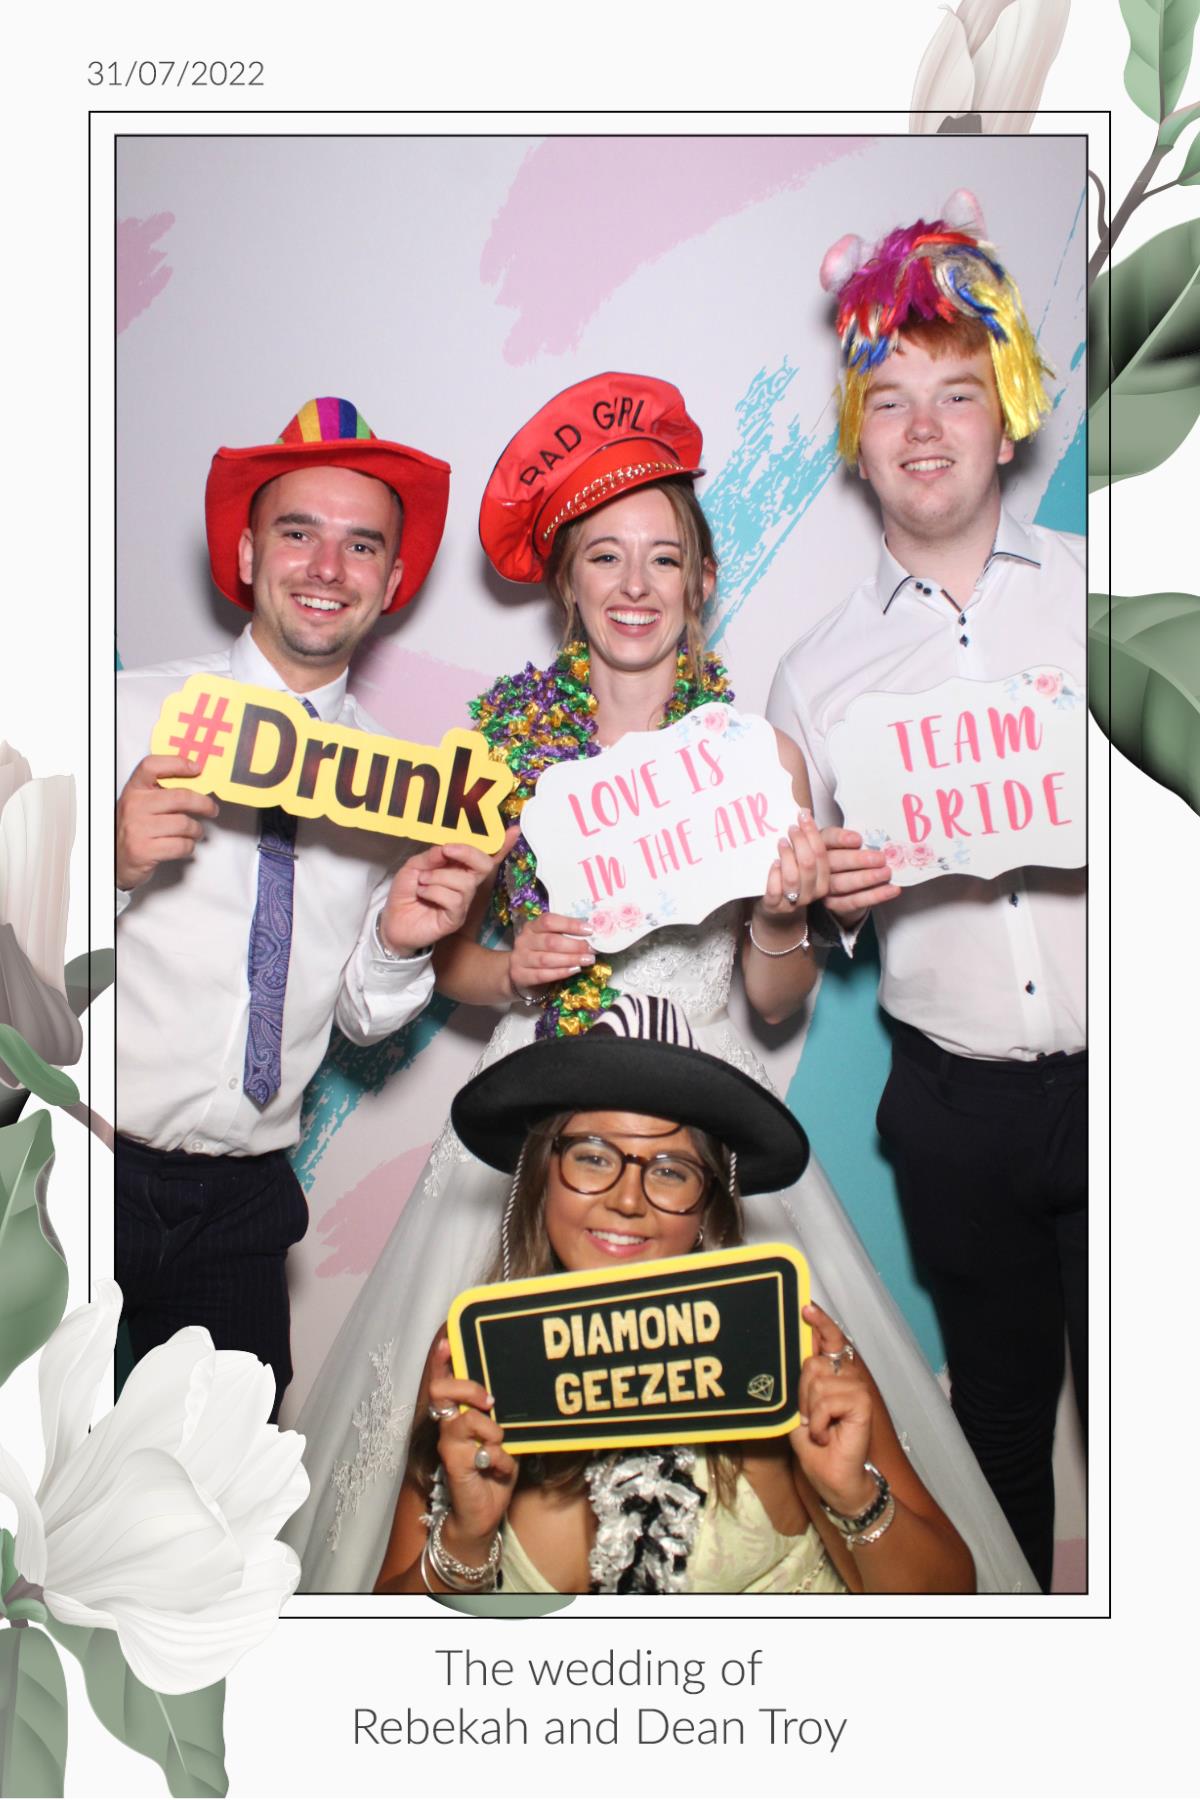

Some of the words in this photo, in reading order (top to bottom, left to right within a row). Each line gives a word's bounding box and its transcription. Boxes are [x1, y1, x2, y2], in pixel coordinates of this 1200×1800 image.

[168, 692, 497, 836] #Drunk
[887, 705, 1043, 773] TEAM
[567, 759, 671, 838] LOVE
[674, 738, 725, 794] IS
[901, 772, 1073, 844] BRIDE
[633, 817, 703, 881] THE
[713, 791, 780, 854] AIR
[542, 1300, 721, 1360] DIAMOND
[554, 1356, 726, 1415] GEEZER
